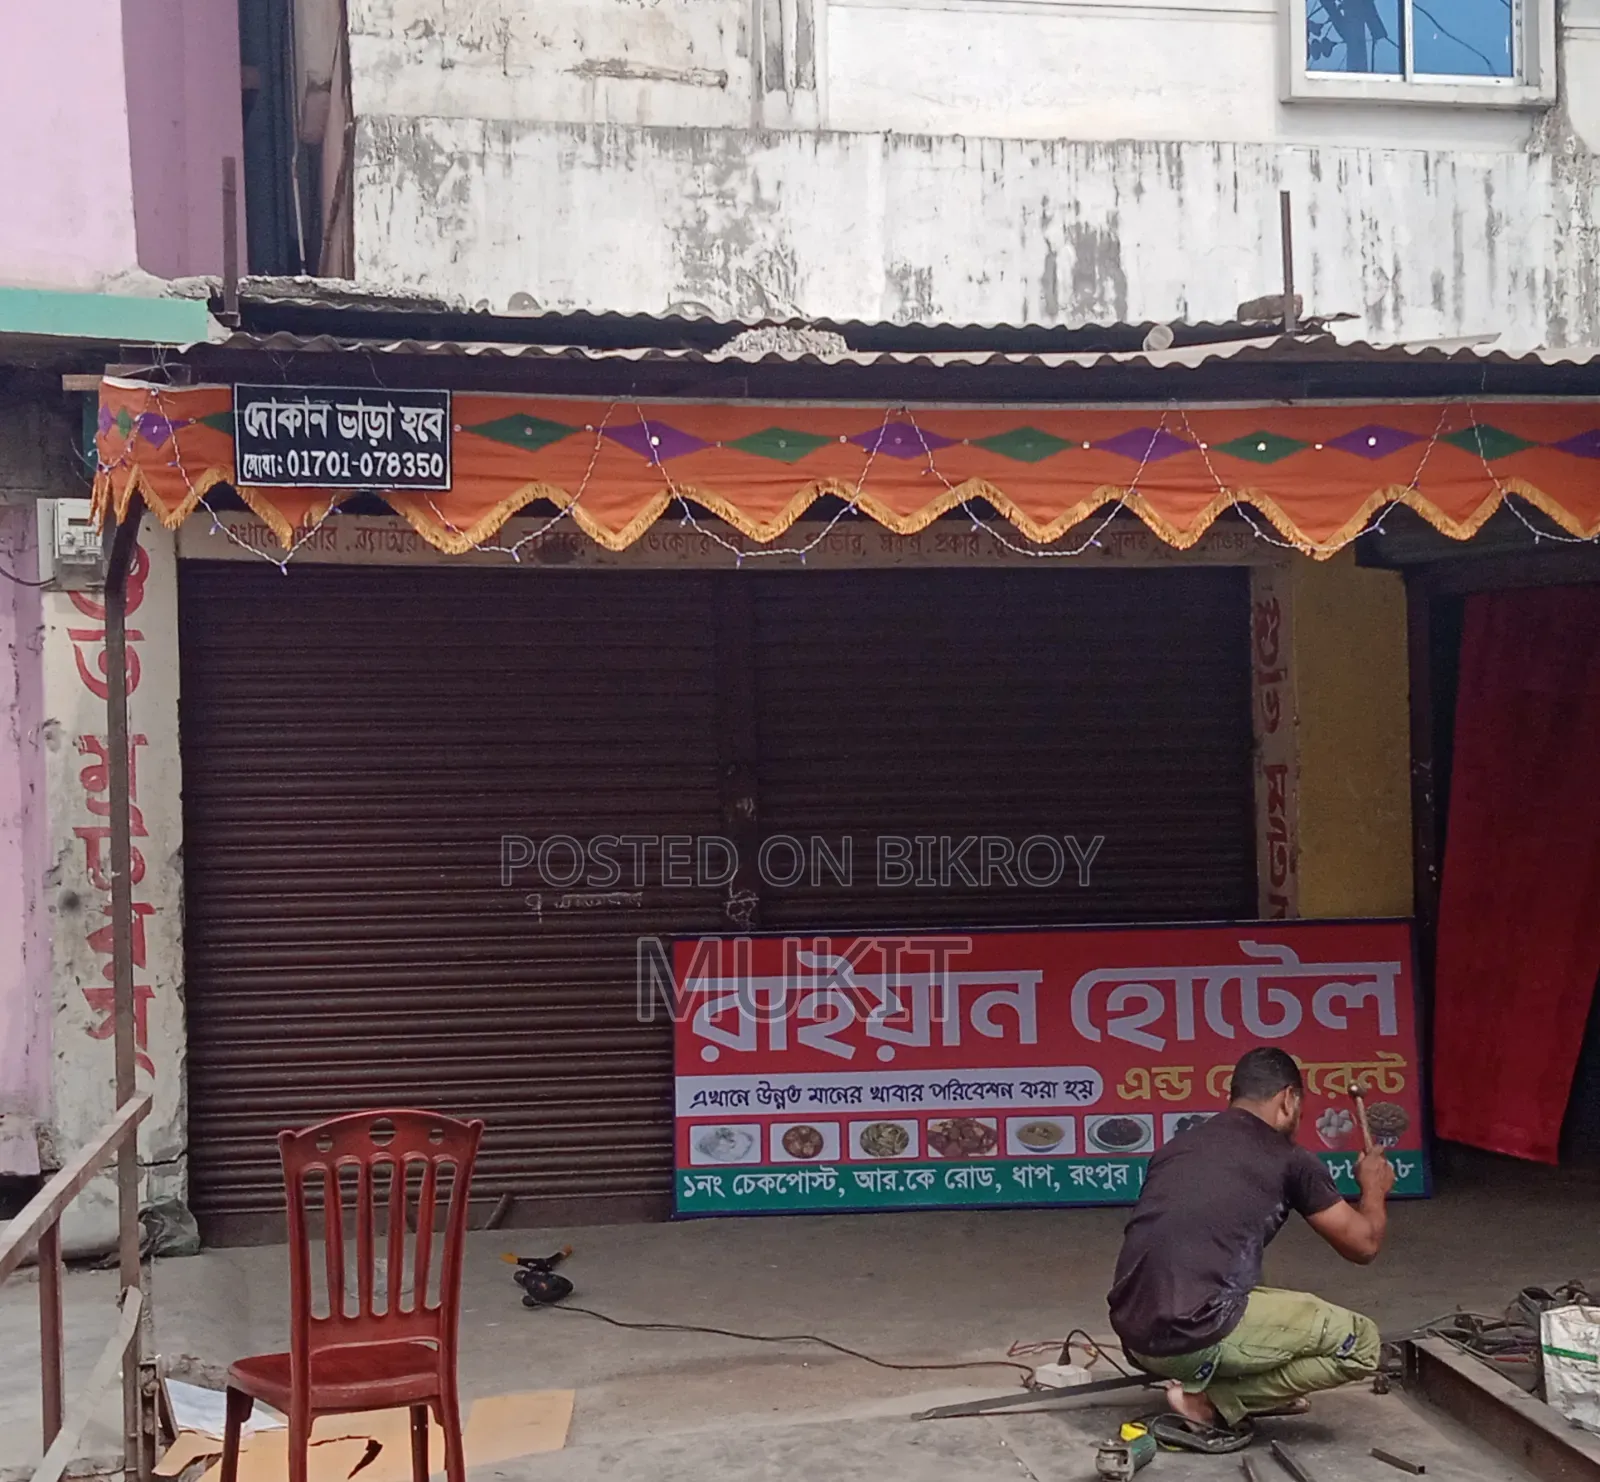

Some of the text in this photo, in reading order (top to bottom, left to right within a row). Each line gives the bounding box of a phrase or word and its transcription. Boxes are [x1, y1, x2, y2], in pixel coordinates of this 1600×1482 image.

[244, 395, 445, 447] দোকান ভাড়া হবে
[287, 449, 444, 479] 01701-078350
[685, 940, 1403, 1063] রাইয়ান হোটেল
[689, 1077, 1097, 1111] এখানে উন্নত মানের খাবার পরিবেশন করা হয়
[1116, 1065, 1195, 1101] এন্ড
[683, 1175, 726, 1199] ১নং
[732, 1163, 846, 1198] চেকপোস্ট,
[944, 1164, 1002, 1194] রোড,
[1012, 1163, 1060, 1193] ধাপ,
